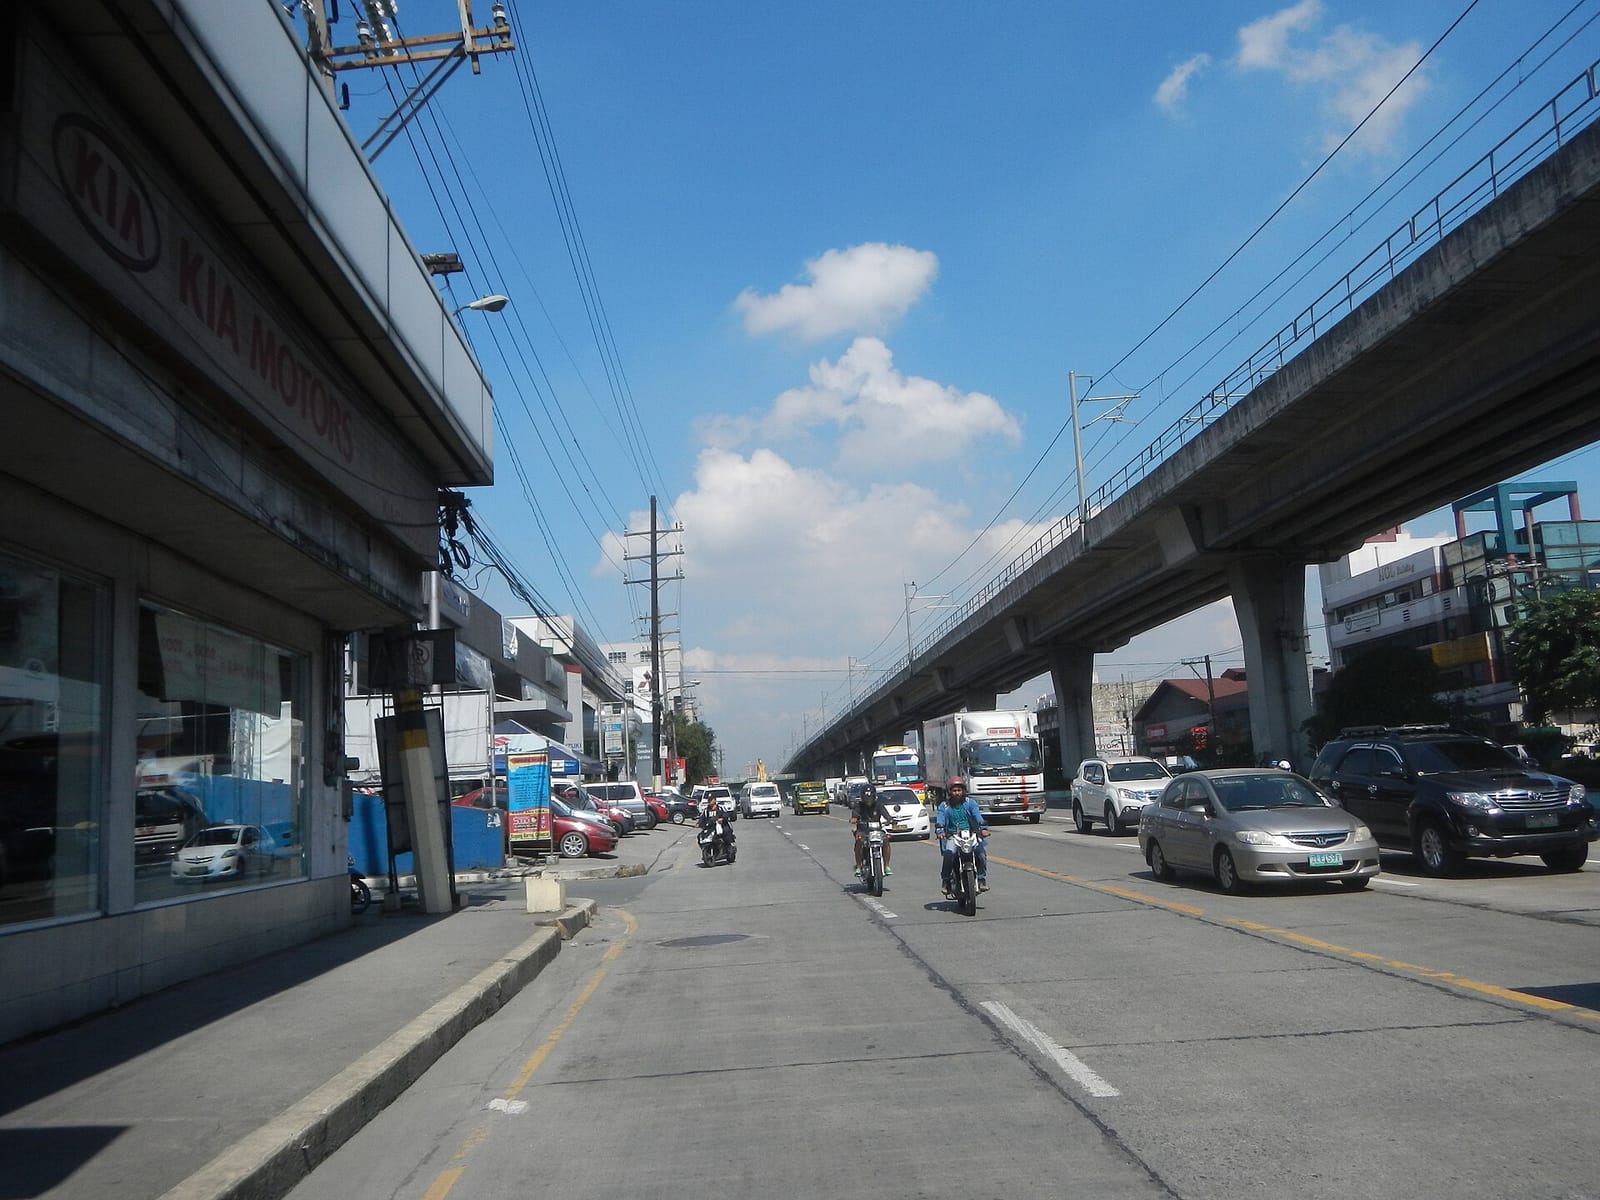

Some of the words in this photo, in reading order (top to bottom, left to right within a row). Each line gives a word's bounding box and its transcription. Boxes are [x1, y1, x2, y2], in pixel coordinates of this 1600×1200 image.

[76, 133, 146, 258] KIA
[179, 237, 240, 355] KIA
[249, 314, 354, 464] MOTORS
